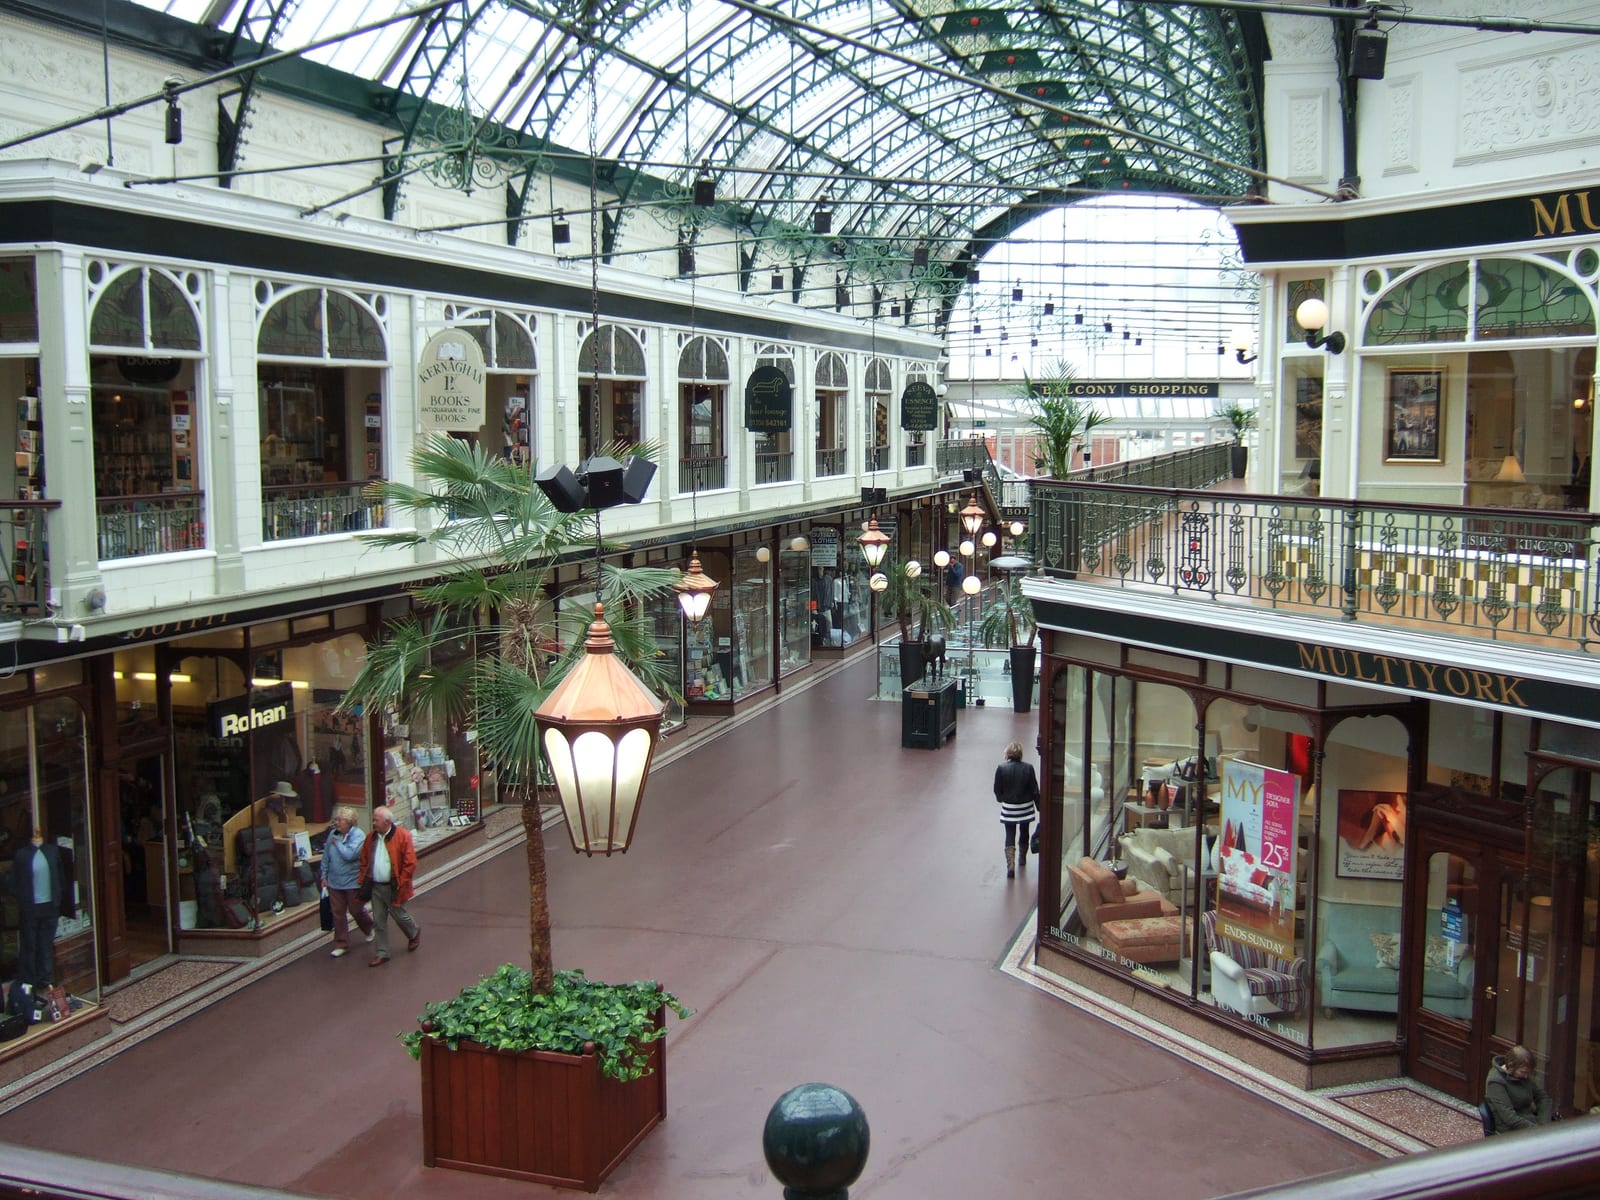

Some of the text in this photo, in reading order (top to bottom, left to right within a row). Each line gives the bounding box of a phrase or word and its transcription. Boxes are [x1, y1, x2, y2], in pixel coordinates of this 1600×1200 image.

[419, 361, 483, 385] KERNAGHAN
[430, 395, 471, 407] BOOKS
[1129, 384, 1209, 395] SHOPPING
[1296, 643, 1529, 707] MULTIYORK
[221, 704, 287, 737] Rohan
[1227, 775, 1270, 805] MY
[1050, 926, 1081, 947] BRISTOL
[1224, 924, 1284, 954] ENDS SUNDAY
[1277, 1023, 1304, 1043] BATH
